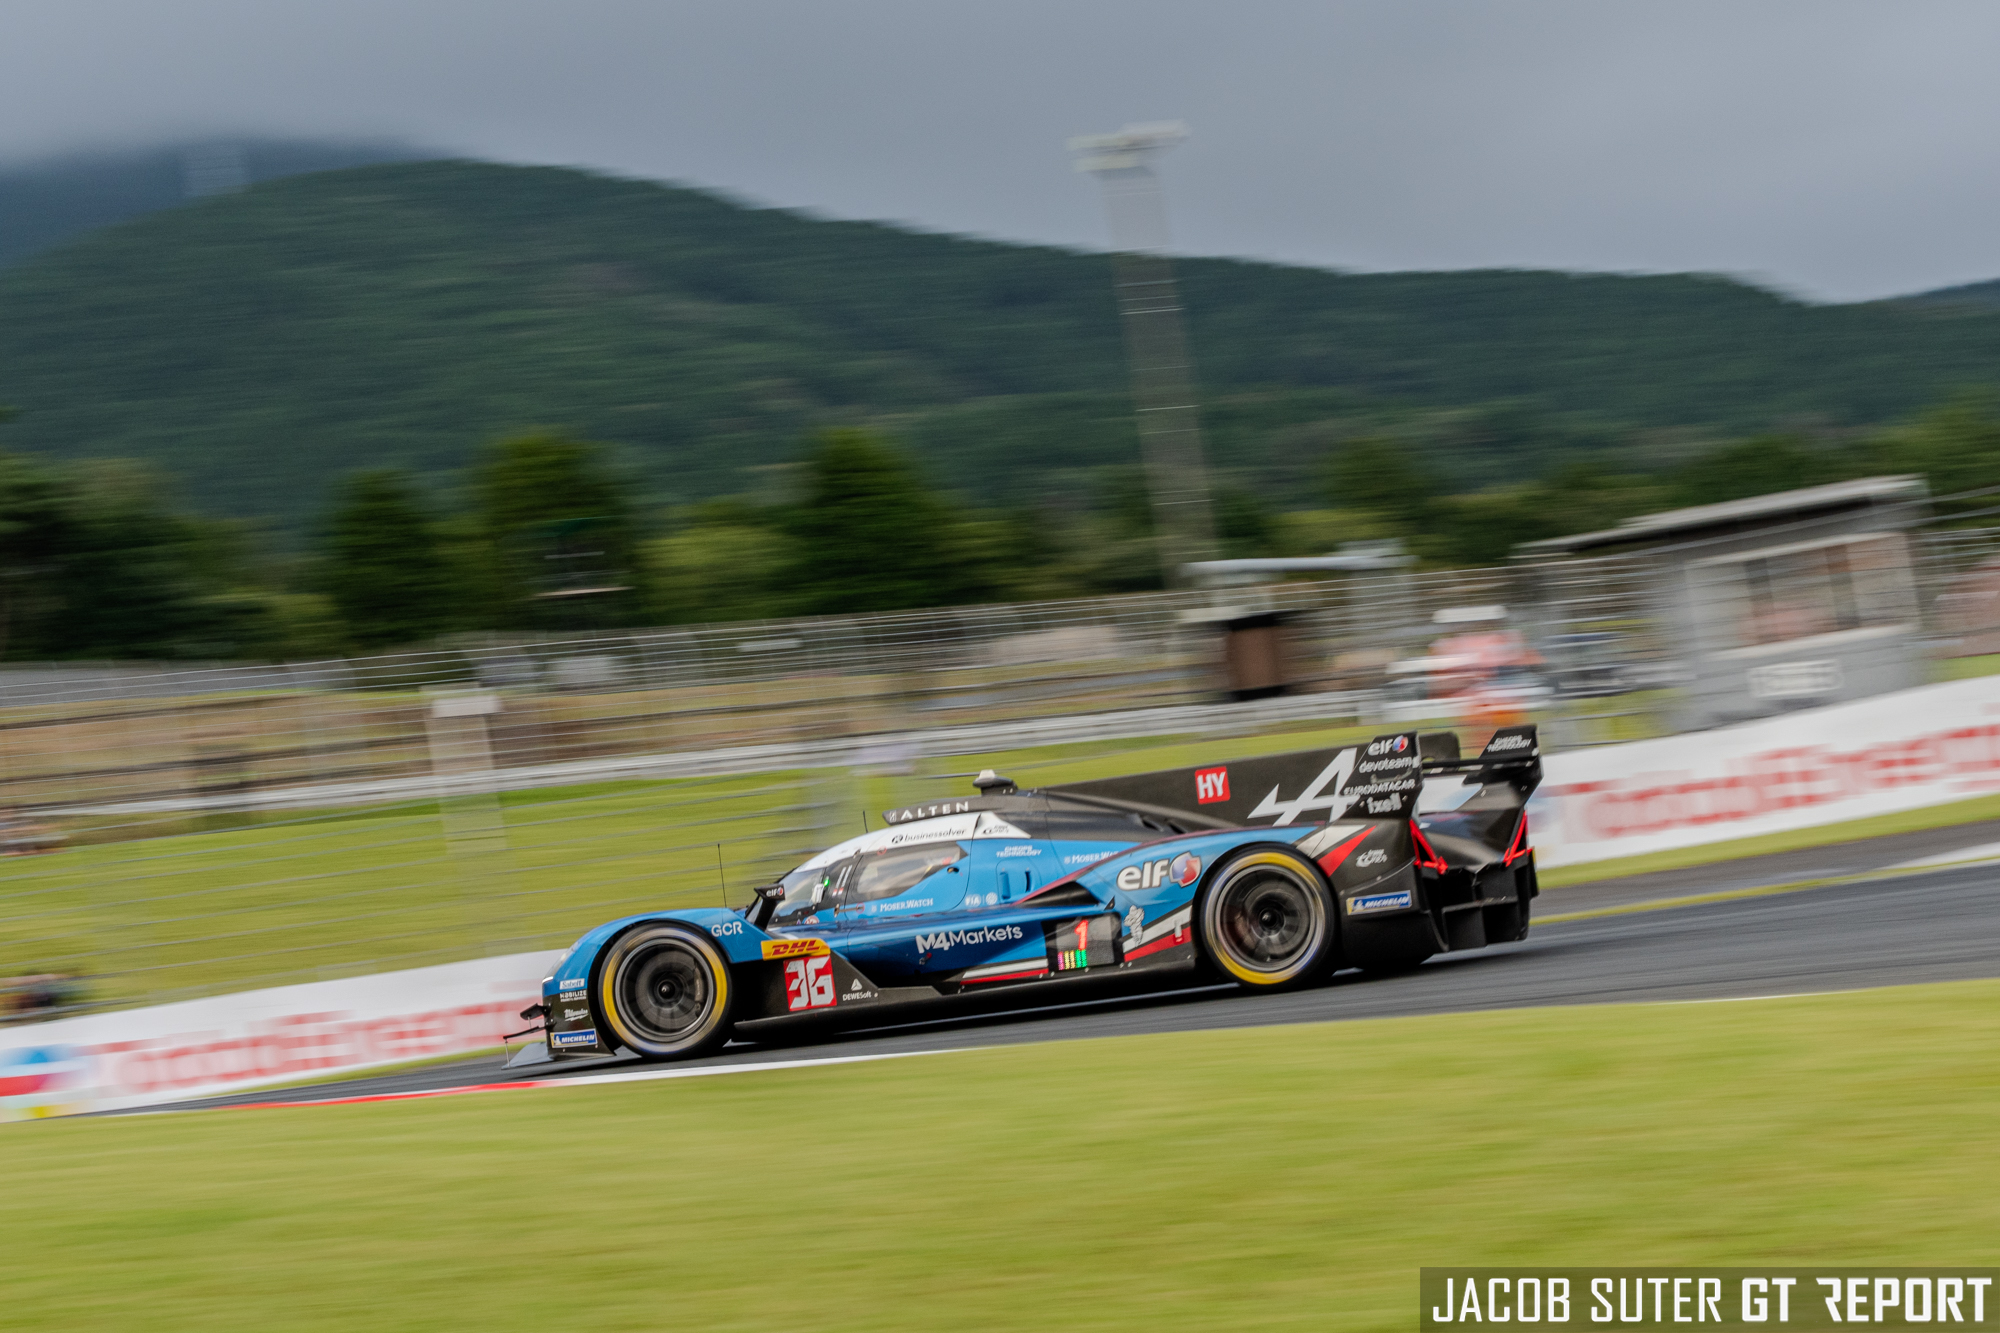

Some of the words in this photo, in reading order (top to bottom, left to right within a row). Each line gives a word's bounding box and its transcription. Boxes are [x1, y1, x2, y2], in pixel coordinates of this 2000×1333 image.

[1367, 739, 1393, 756] elf
[1359, 756, 1412, 773] devoteam
[1196, 771, 1226, 800] HY
[900, 801, 969, 820] ALTEN
[904, 828, 966, 841] businessolver
[1117, 858, 1170, 892] elf
[766, 886, 778, 897] elf
[1364, 896, 1410, 908] MICHELIN
[711, 920, 743, 937] GCR
[1074, 919, 1089, 951] 1
[772, 939, 820, 956] DHL
[915, 924, 1023, 954] M4Markets
[786, 954, 835, 1009] 36
[561, 1034, 595, 1043] MICHELIN
